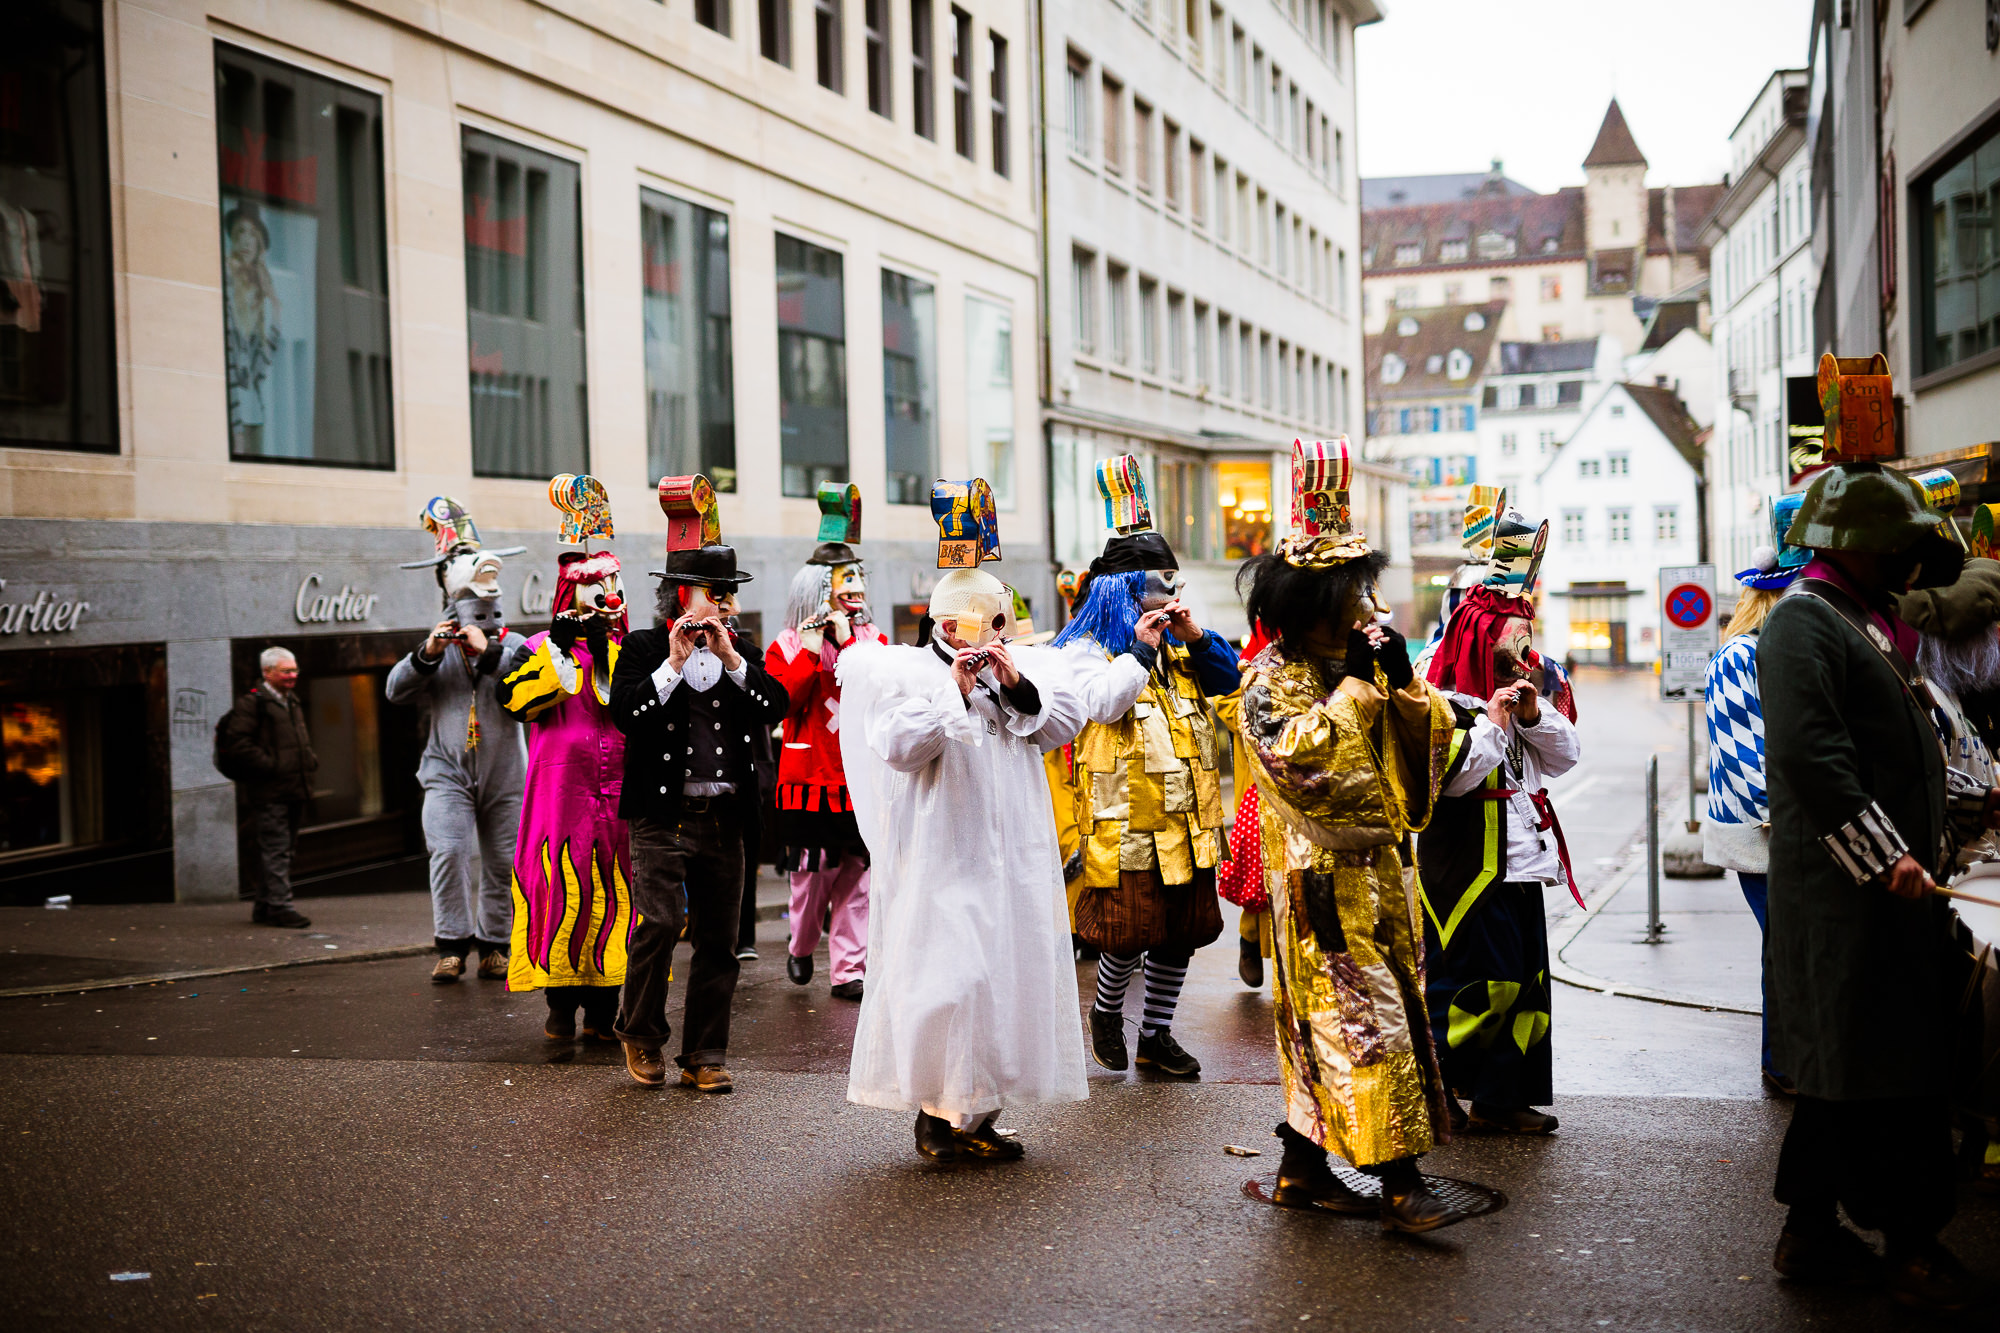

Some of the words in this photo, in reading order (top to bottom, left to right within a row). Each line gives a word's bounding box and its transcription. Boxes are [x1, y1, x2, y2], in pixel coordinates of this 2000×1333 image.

[0, 578, 90, 633] artier
[296, 572, 379, 622] Cartier
[1674, 652, 1695, 666] 100
